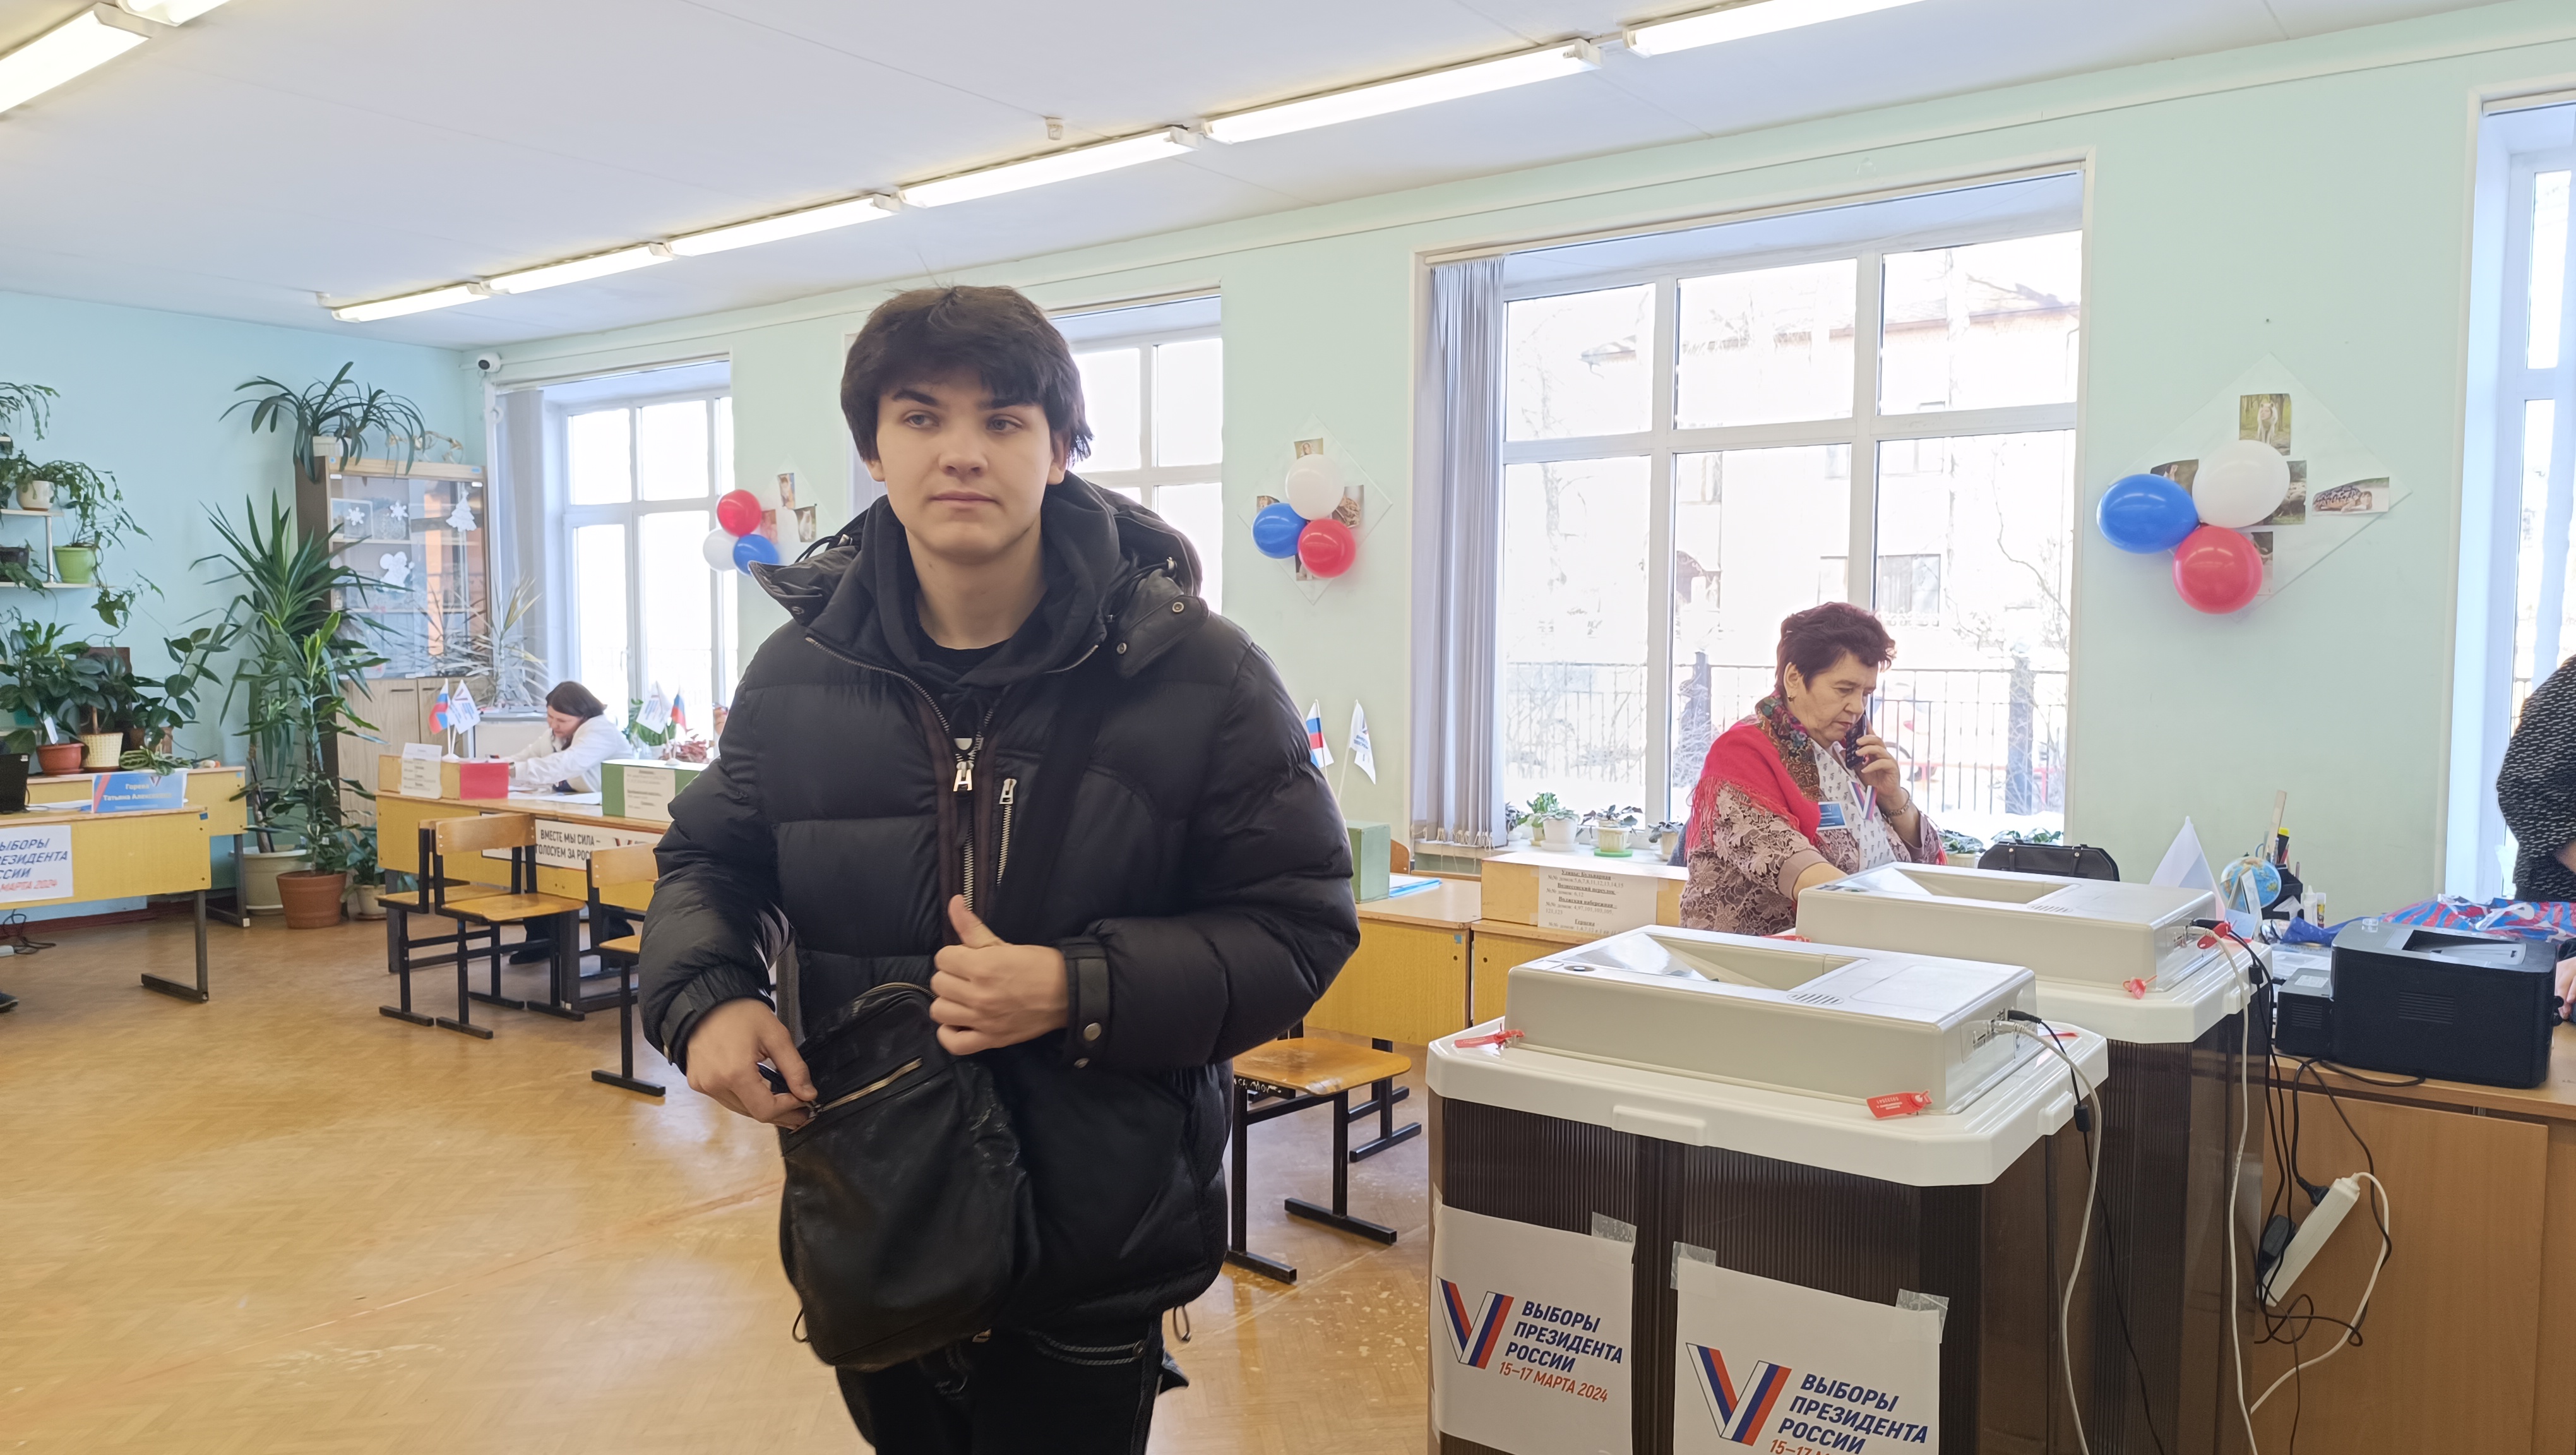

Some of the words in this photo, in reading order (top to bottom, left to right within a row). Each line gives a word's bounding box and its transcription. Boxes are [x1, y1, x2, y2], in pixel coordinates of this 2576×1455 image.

[0, 838, 51, 852] ЫБОРЫ
[540, 829, 563, 843] ВМЕСТЕ
[564, 832, 576, 844] МЫ
[577, 834, 594, 846] СИЛА
[0, 851, 68, 865] ЕЗИДЕНТА
[568, 848, 576, 859] ЗА
[576, 849, 590, 861] РОС
[1557, 883, 1591, 892] Вознесенский
[1581, 872, 1611, 880] Бульварная
[1558, 896, 1583, 904] Волжская
[1583, 899, 1613, 908] набережная
[1522, 1301, 1601, 1333] ВЫБОРЫ
[1513, 1321, 1623, 1364] ПРЕЗИДЕНТА
[1505, 1342, 1576, 1373] РОССИИ
[1499, 1362, 1533, 1381] 15–17
[1533, 1370, 1576, 1394] МАРТА
[1577, 1382, 1608, 1403] 2024
[1800, 1374, 1899, 1412] ВЫБОРЫ
[1789, 1396, 1928, 1444] ПРЕЗИДЕНТА
[1778, 1418, 1866, 1454] РОССИИ
